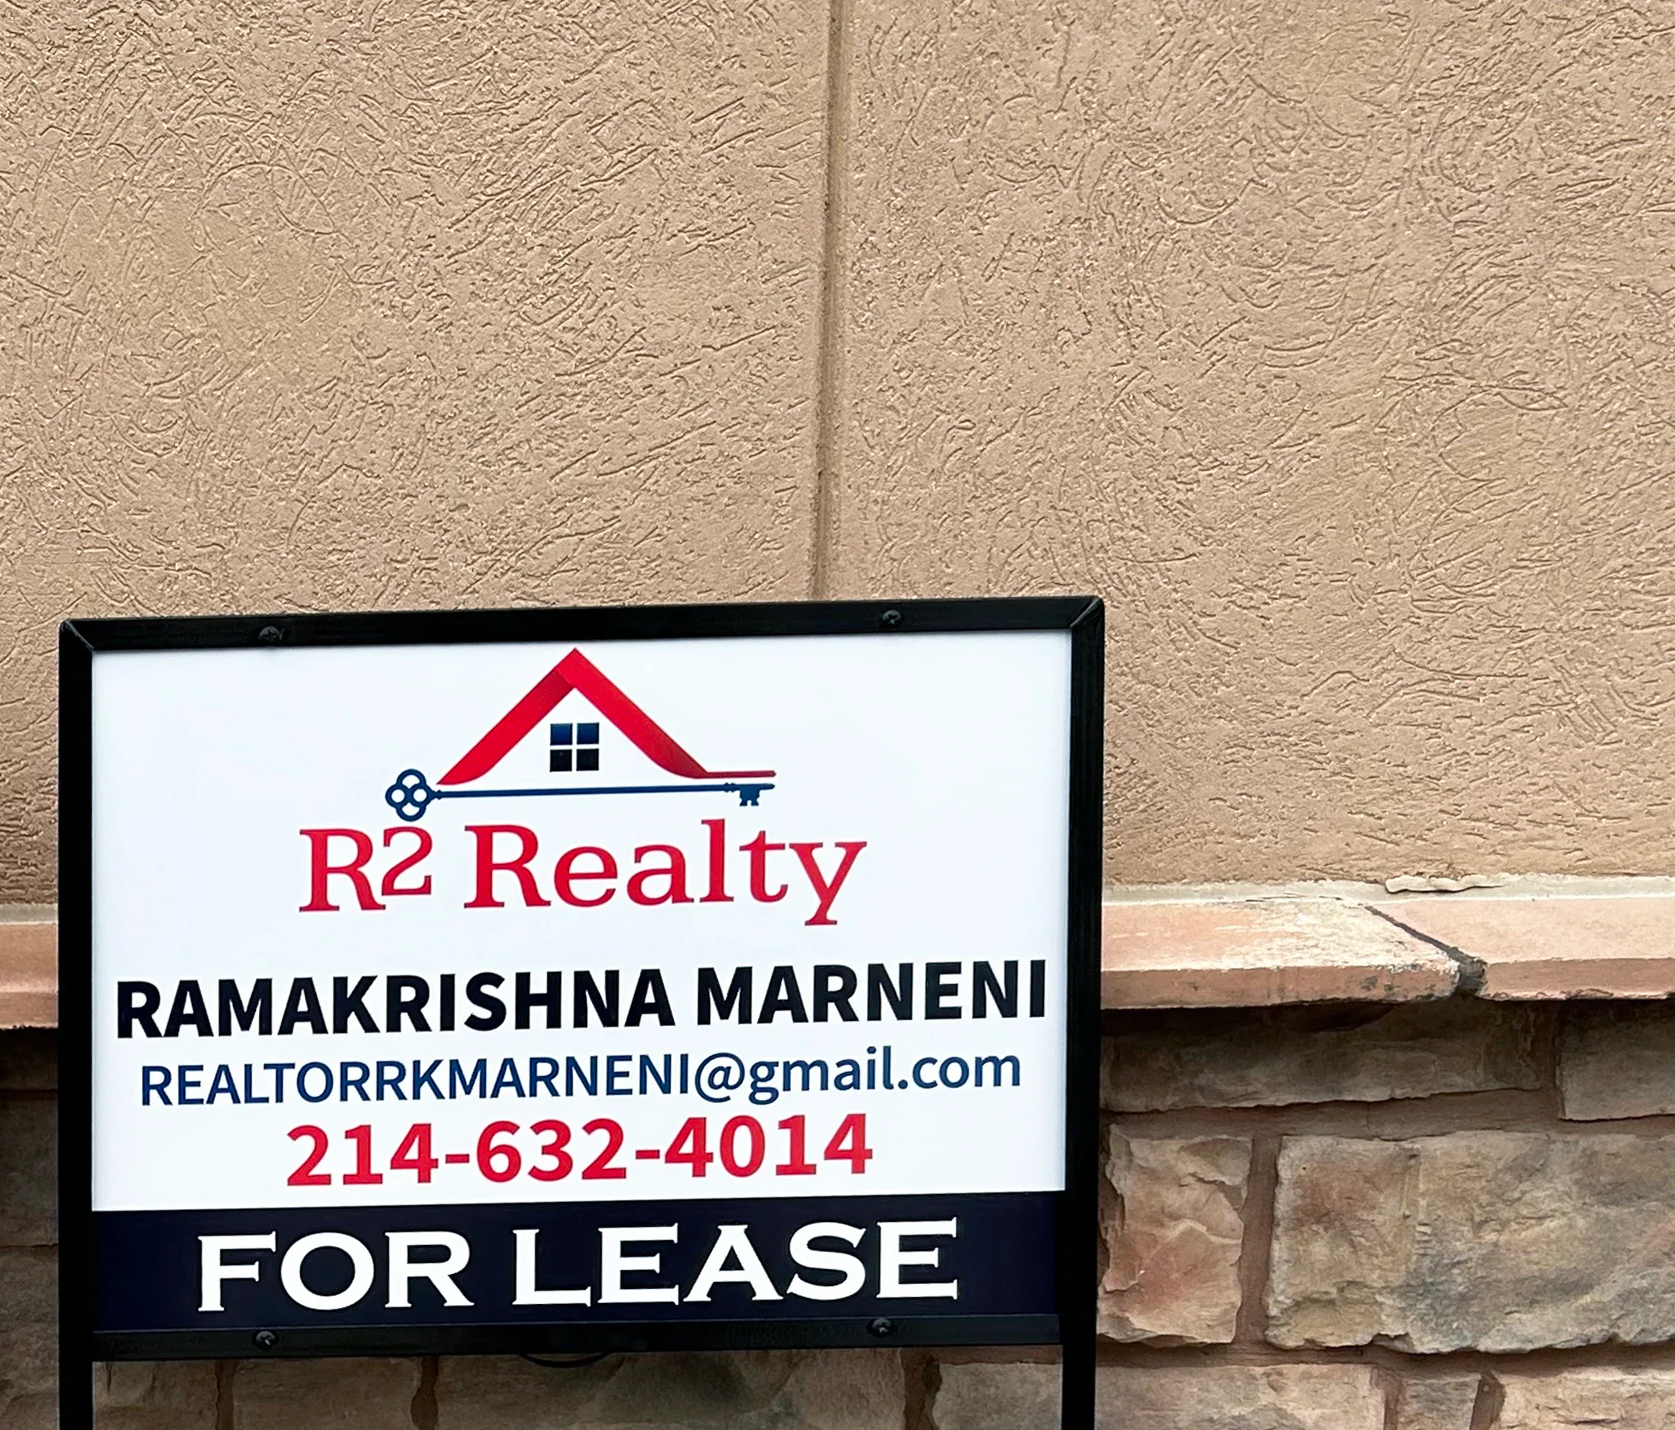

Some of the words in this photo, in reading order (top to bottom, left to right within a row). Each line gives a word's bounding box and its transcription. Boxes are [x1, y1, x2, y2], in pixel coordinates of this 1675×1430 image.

[301, 827, 432, 911] R2
[467, 819, 865, 925] Realty
[118, 969, 675, 1038] RAMAKRISHNA
[698, 960, 1045, 1025] MARNENI
[142, 1046, 1020, 1106] REALTORRKMARNENI@gmail.com
[288, 1114, 872, 1186] 214-632-4014
[198, 1231, 474, 1311] FOR
[513, 1217, 957, 1306] LEASE
